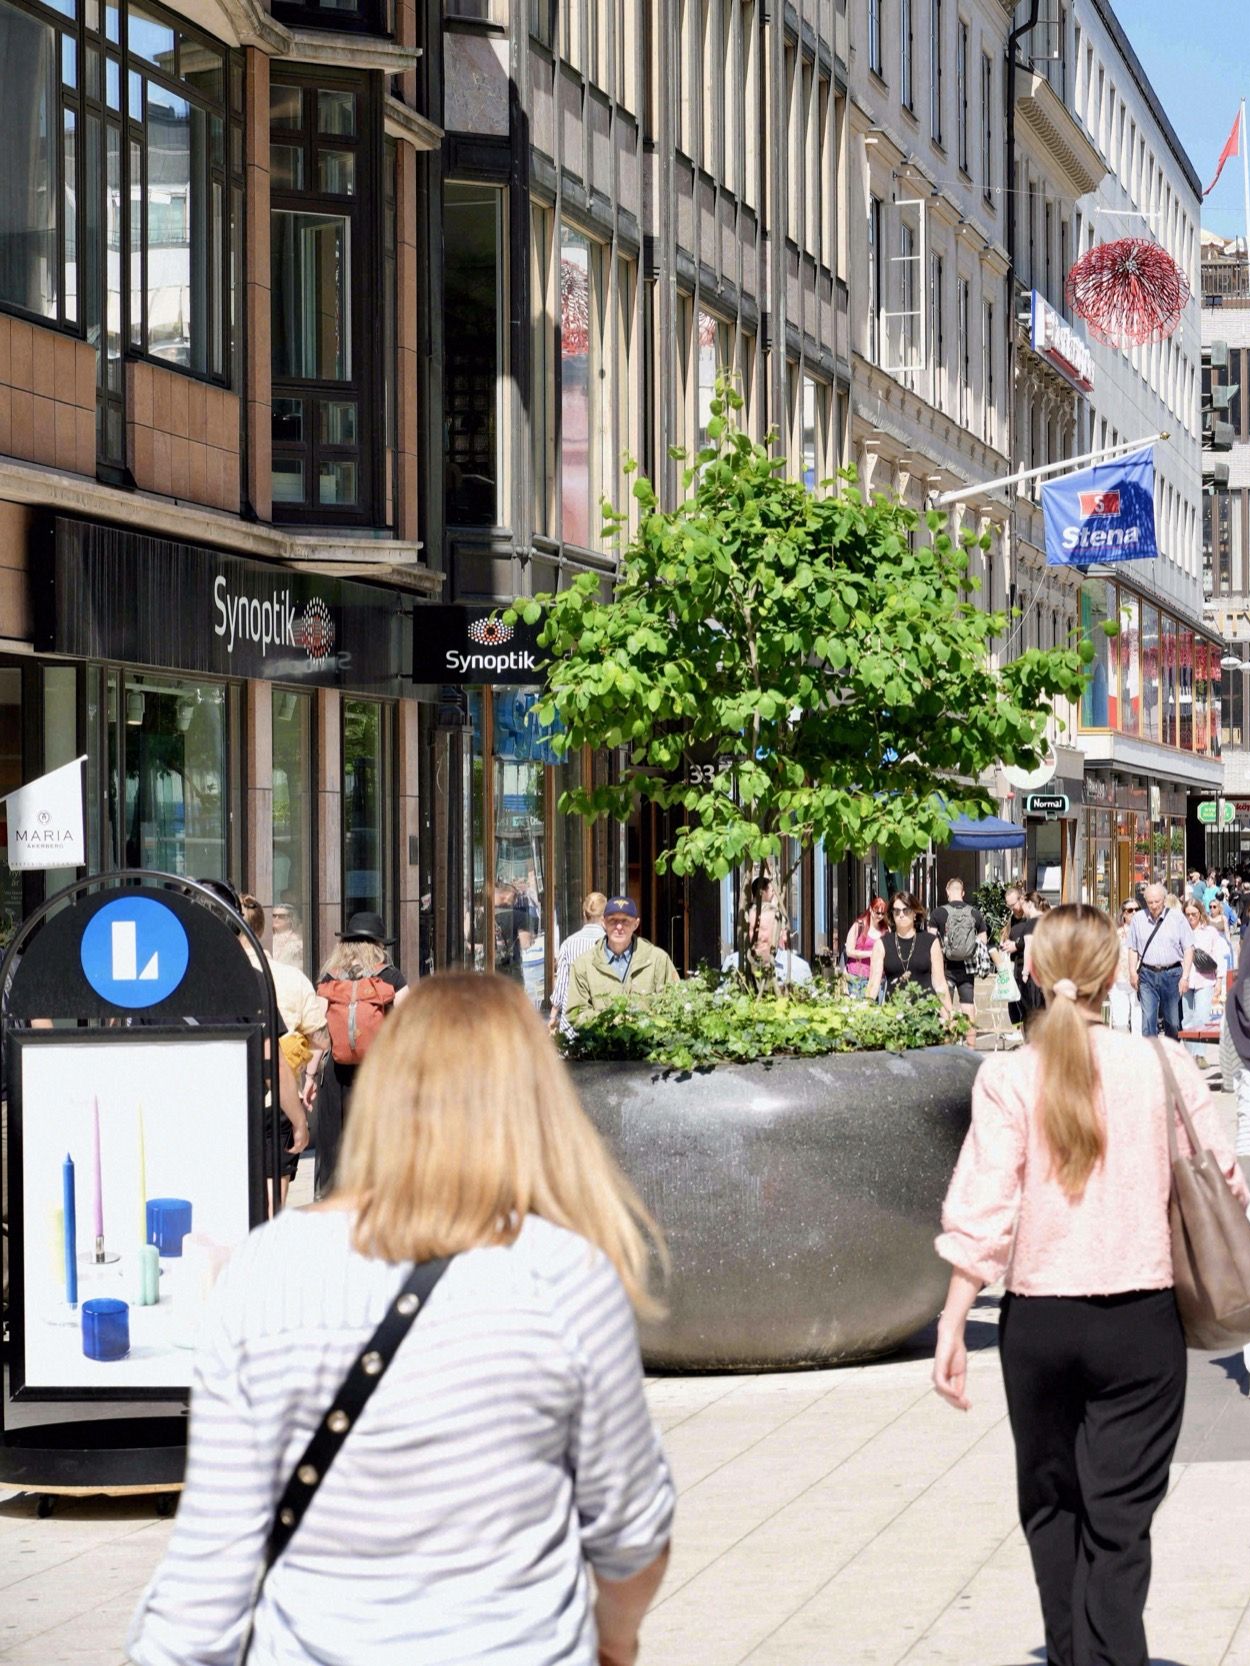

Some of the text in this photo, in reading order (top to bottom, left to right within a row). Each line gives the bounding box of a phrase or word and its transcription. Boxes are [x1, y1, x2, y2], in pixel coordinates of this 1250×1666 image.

[1062, 526, 1141, 549] Stena
[214, 575, 296, 656] Synoptik
[446, 650, 535, 673] Synoptik
[1033, 798, 1062, 808] Normal
[16, 830, 73, 841] MARIA
